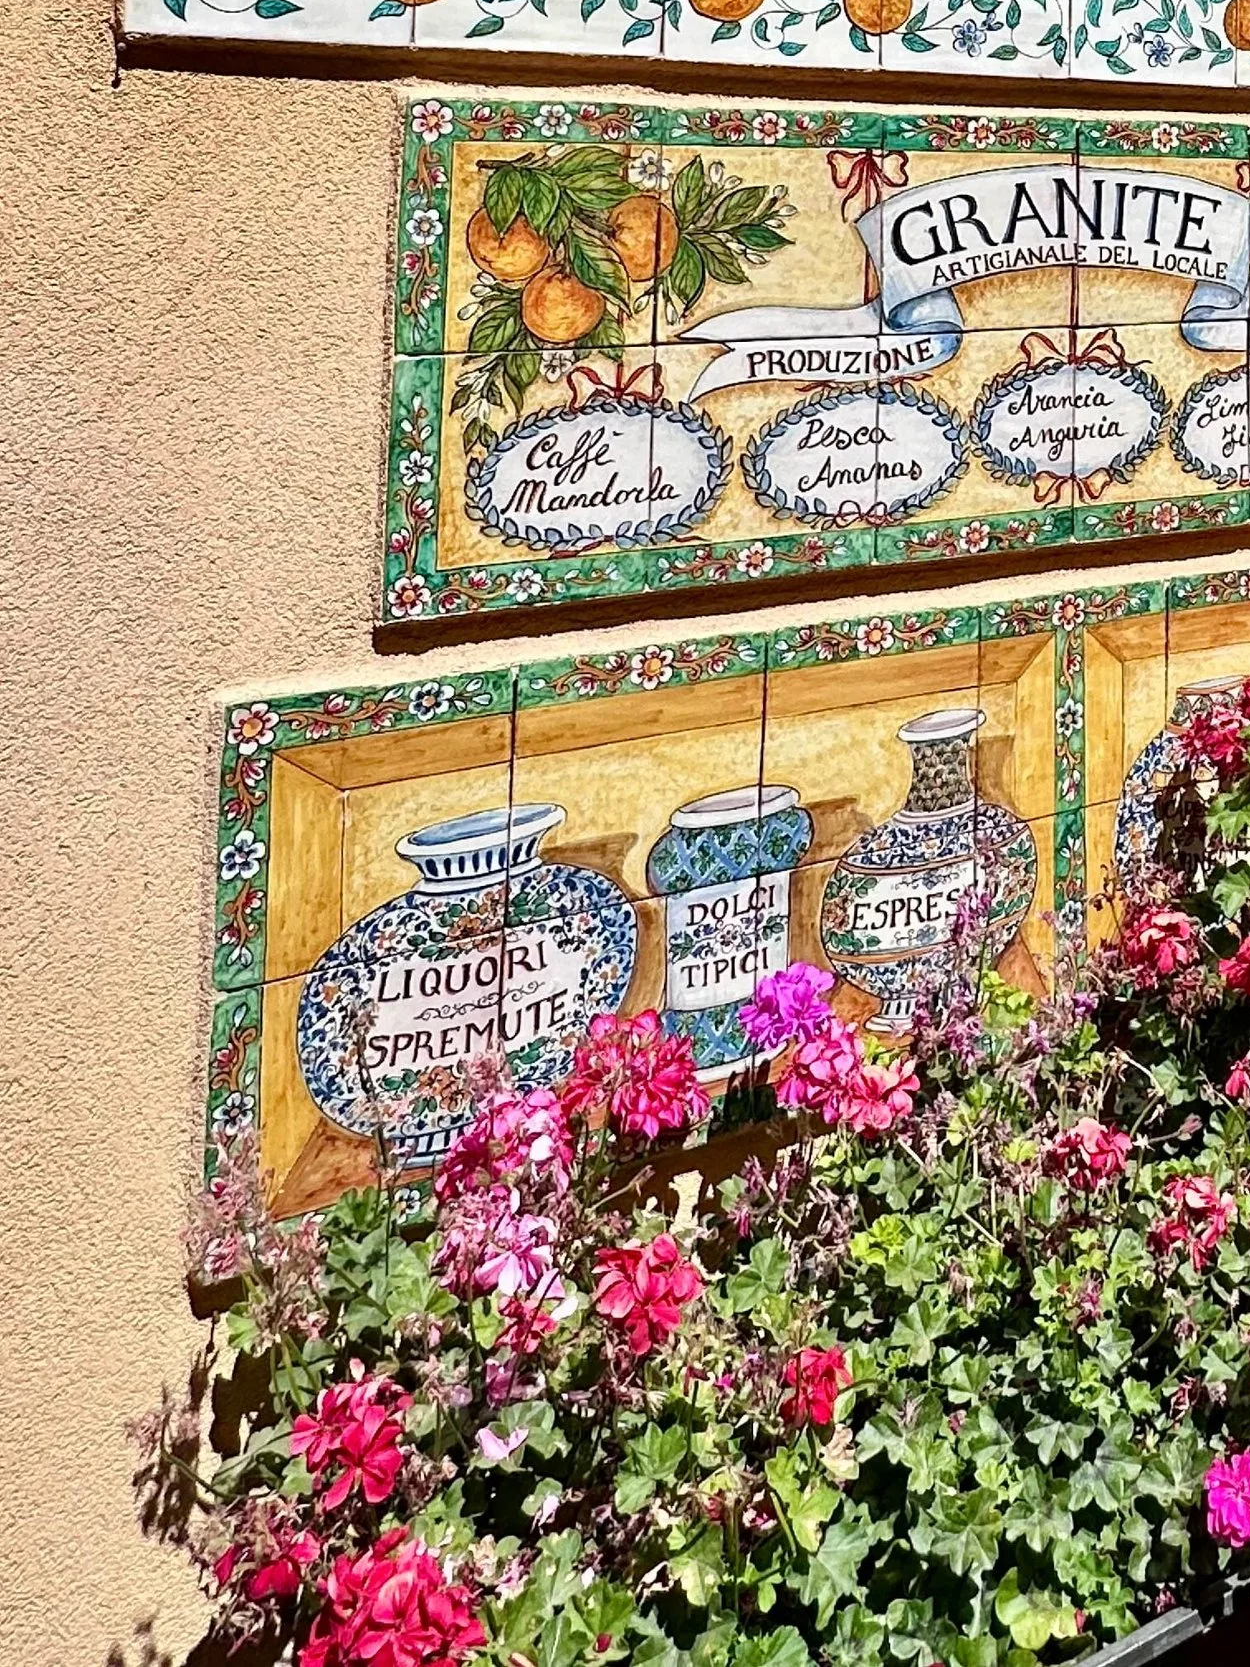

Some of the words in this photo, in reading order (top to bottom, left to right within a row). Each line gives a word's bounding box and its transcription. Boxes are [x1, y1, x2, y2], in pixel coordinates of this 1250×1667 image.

[890, 178, 1222, 266] GRANITE
[932, 242, 1087, 286] ARTIGIANALE
[1098, 245, 1139, 266] DEL
[1153, 249, 1228, 280] LOCALE
[746, 338, 934, 379] PRODUZIONE
[1008, 385, 1114, 416] Arancia
[797, 418, 895, 451] Pesca
[1008, 416, 1127, 461] Anguria
[500, 465, 681, 515] Mandorla
[798, 455, 923, 492] Ananas
[686, 885, 776, 926] DOLCI
[852, 887, 964, 931] ESPRES
[377, 939, 548, 1002] LIQUORI
[680, 947, 769, 989] TIPICI
[366, 988, 569, 1069] SPREMUTE
